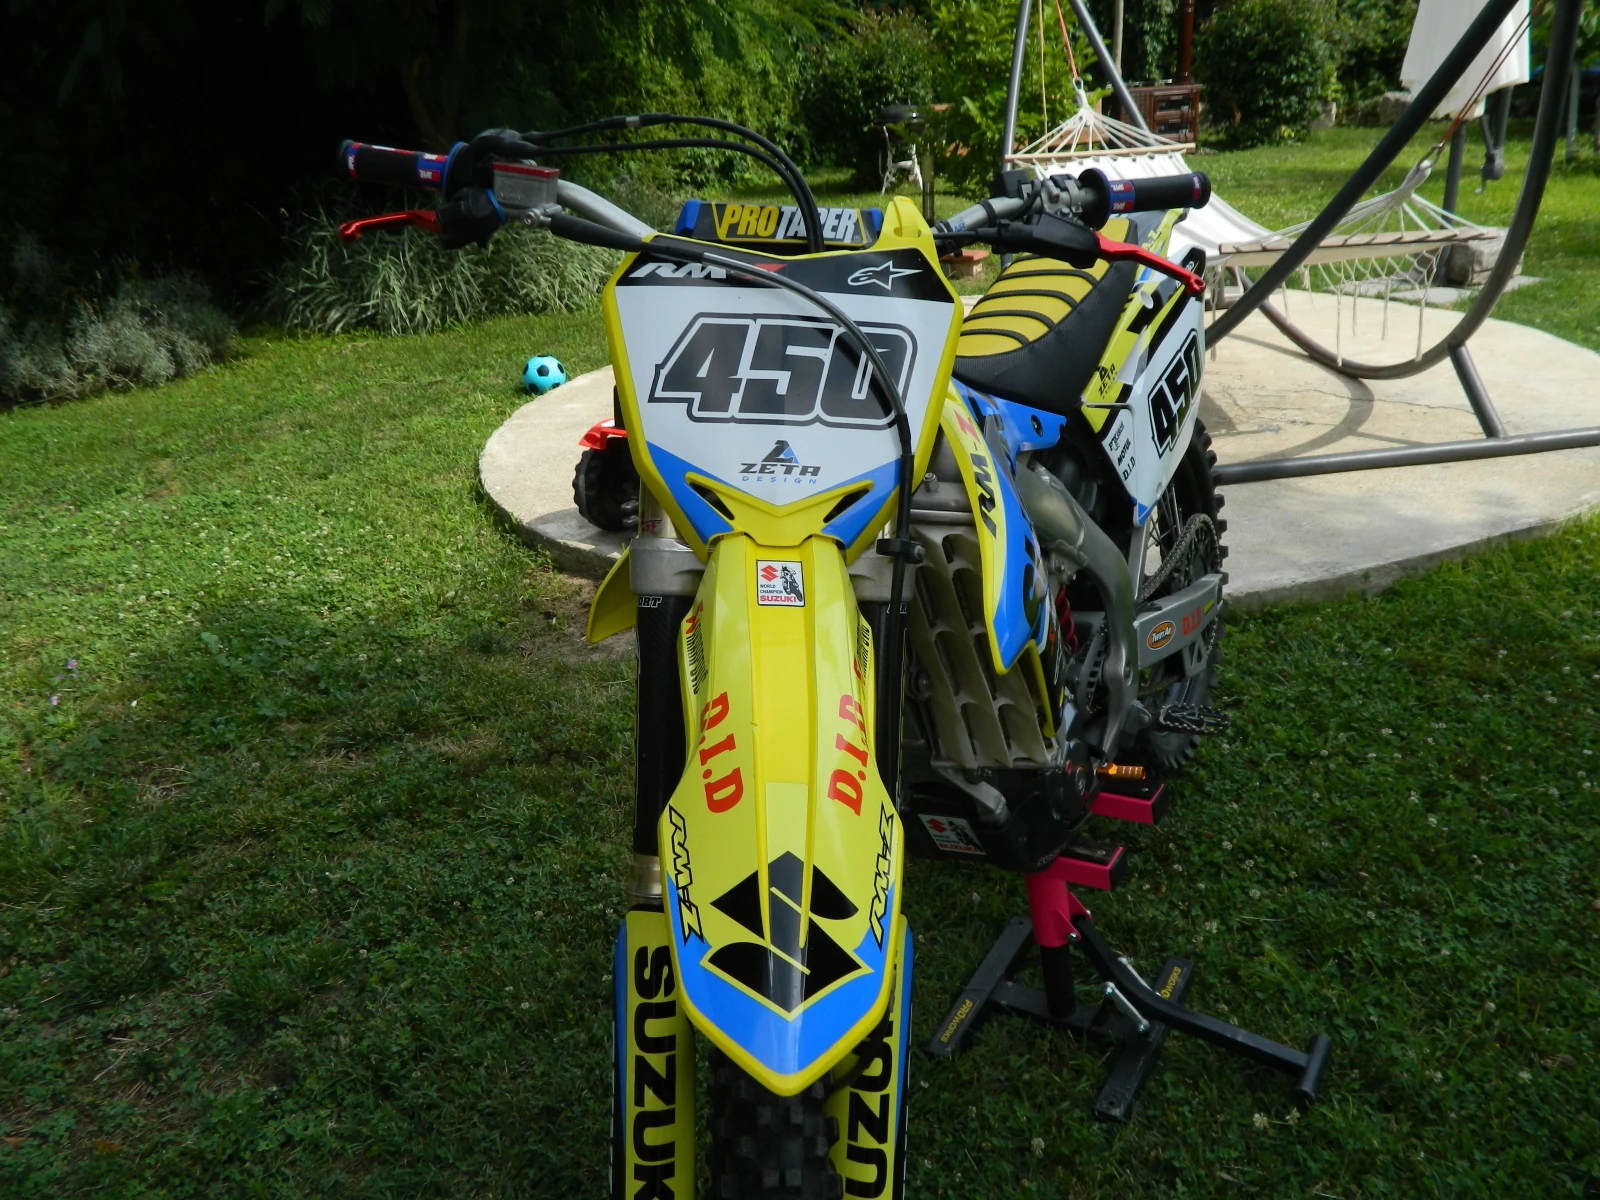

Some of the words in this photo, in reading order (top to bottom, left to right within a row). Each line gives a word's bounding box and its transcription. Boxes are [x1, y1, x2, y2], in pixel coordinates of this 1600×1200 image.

[648, 312, 917, 430] 450
[1148, 328, 1202, 459] 450
[739, 463, 821, 476] ZETA
[742, 475, 817, 484] DESIGN
[953, 409, 997, 539] RM-Z
[1122, 456, 1136, 481] D.I.D
[698, 691, 744, 814] D.I.D
[827, 694, 869, 817] D.I.D
[669, 804, 704, 946] RM-Z
[870, 801, 894, 952] RM-Z
[940, 999, 973, 1043] PROWORKS
